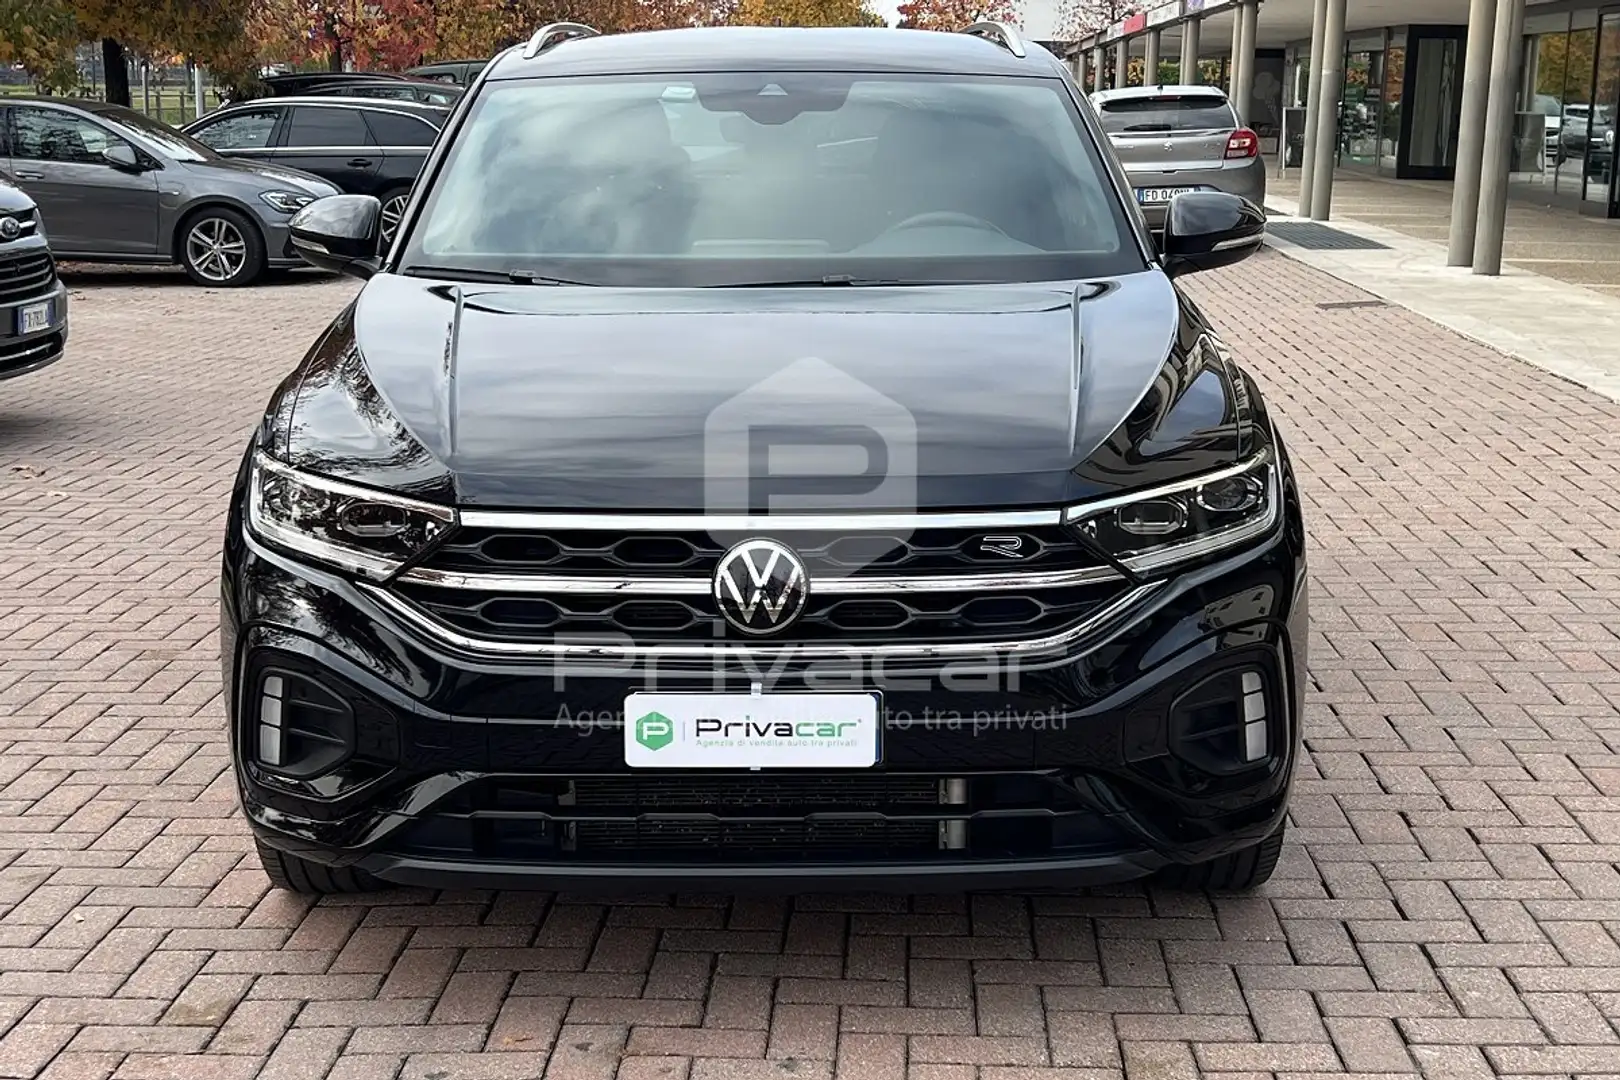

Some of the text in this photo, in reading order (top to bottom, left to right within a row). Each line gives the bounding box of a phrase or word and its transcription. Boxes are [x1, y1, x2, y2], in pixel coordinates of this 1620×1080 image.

[1145, 190, 1158, 200] FD
[695, 715, 857, 737] Privacar
[696, 739, 733, 748] Agenzia
[827, 739, 858, 748] privati
